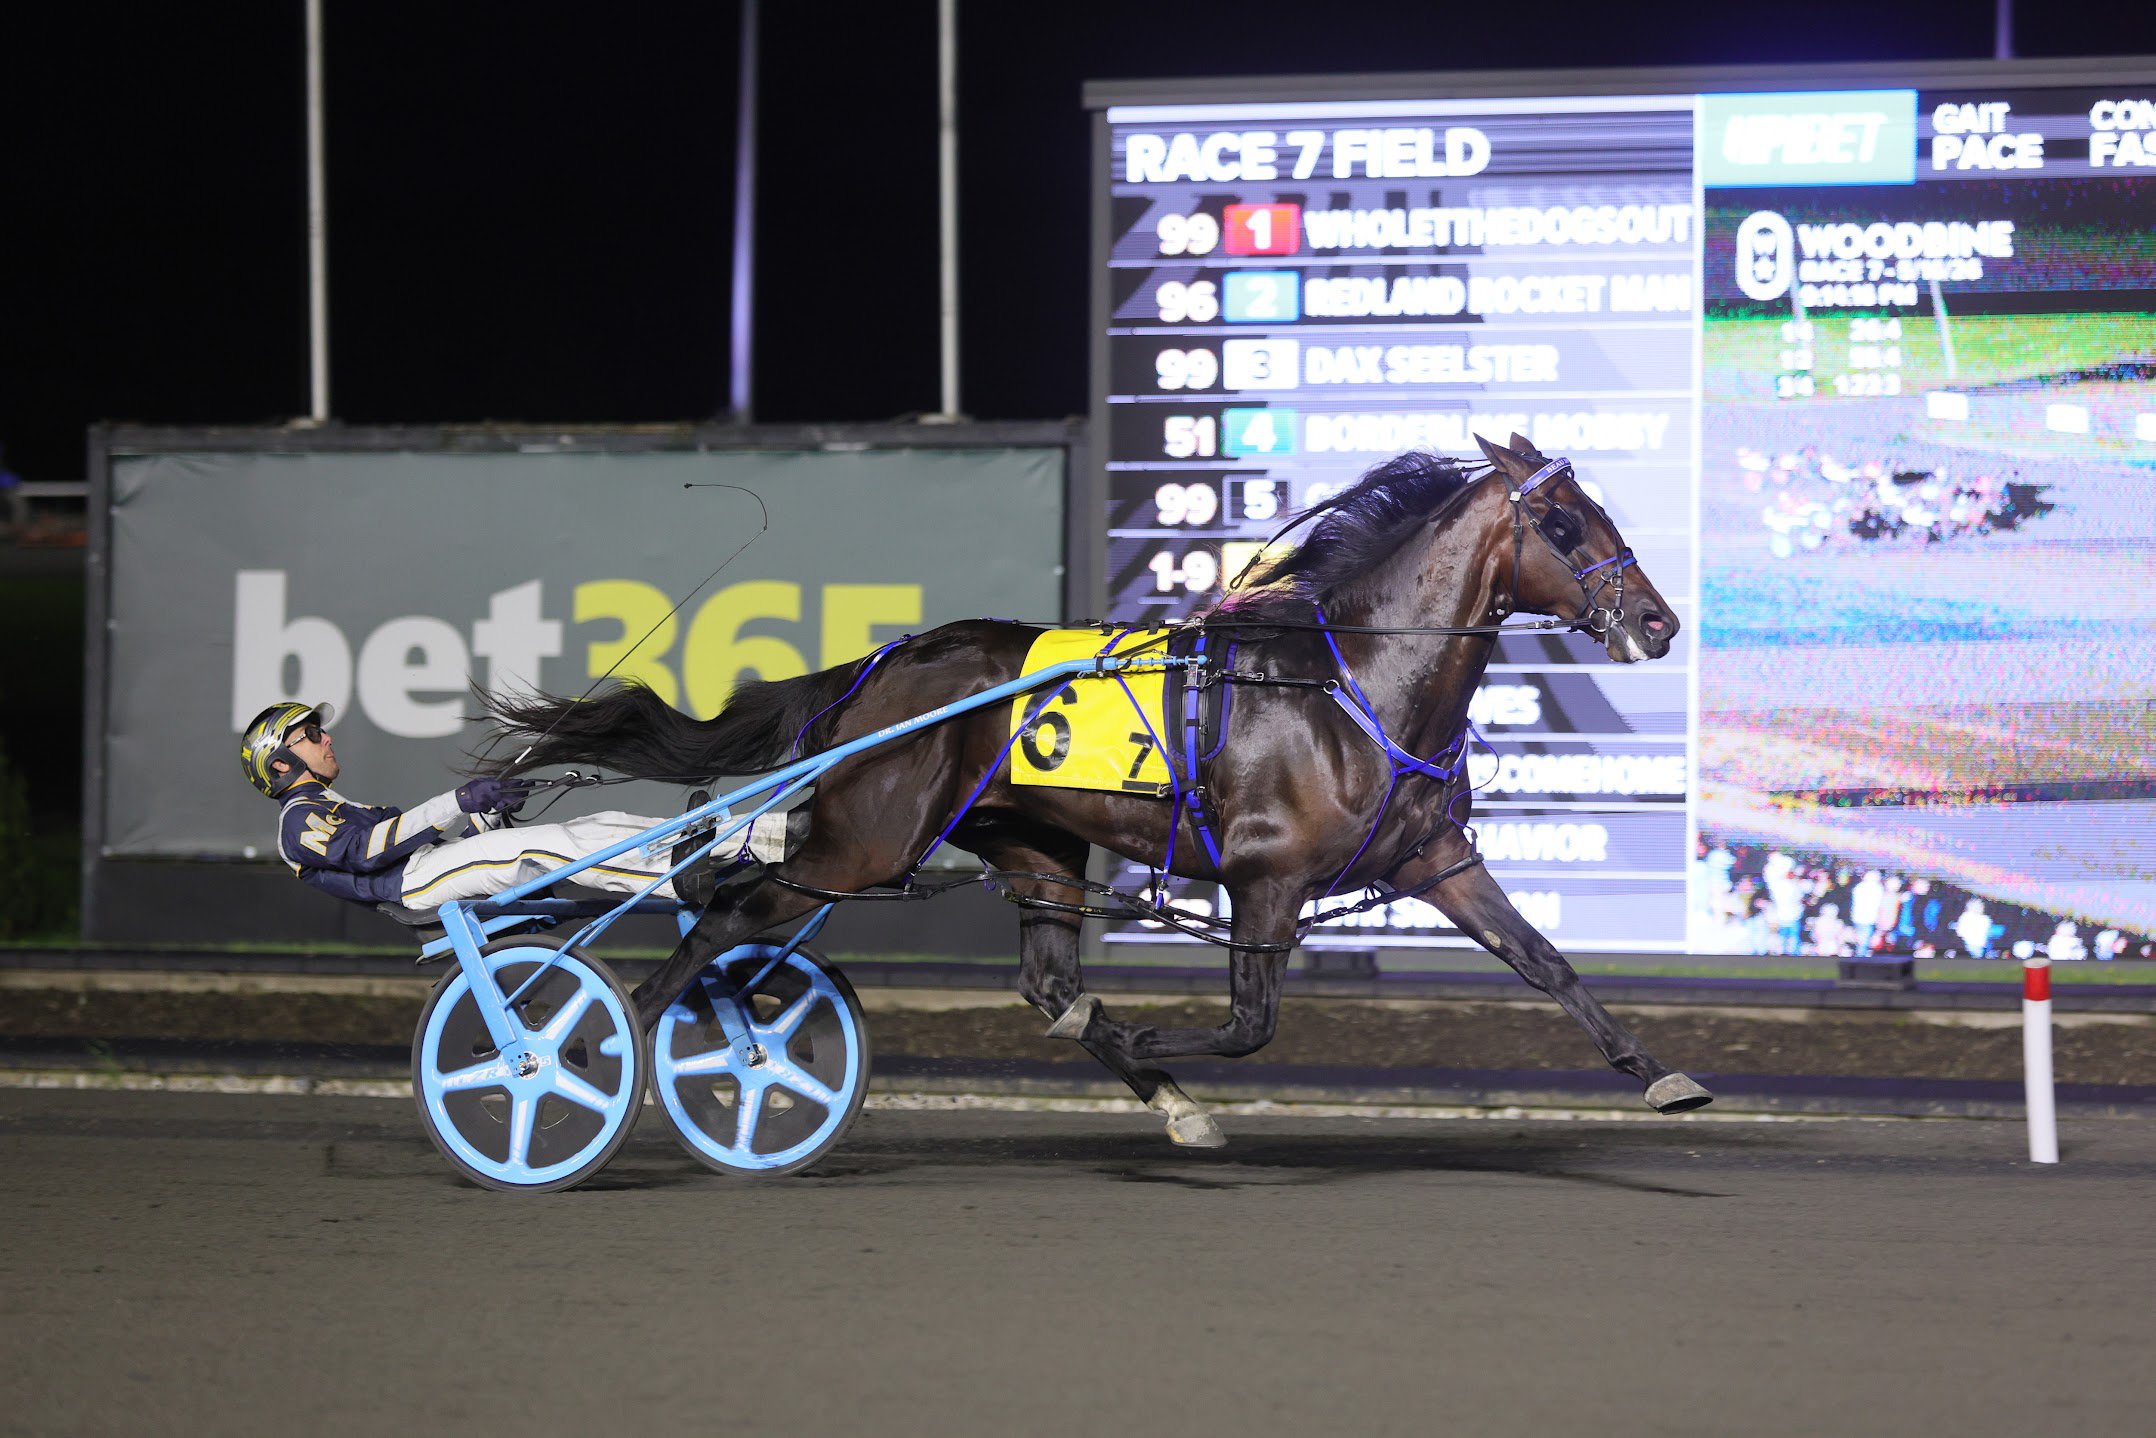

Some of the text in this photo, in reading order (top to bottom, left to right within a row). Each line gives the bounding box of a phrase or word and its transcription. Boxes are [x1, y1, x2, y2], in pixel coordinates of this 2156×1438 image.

[1932, 102, 2011, 134] GAIT
[1126, 128, 1491, 182] RACE 7 FIELD
[1932, 133, 2044, 170] PACE
[1156, 205, 1692, 255] 99 1 WHOLETTHEDOGSOUT
[1797, 221, 2015, 260] WOODBINE
[1800, 259, 1865, 282] RACE
[1867, 259, 1885, 281] 7
[1156, 273, 1691, 323] 96 2 REDLAND ROCKET MAN
[1156, 345, 1559, 390] 99 3 DAX SEELSTER
[1164, 416, 1216, 457] 51
[1242, 411, 1276, 450] 4
[1155, 483, 1217, 526] 99
[1244, 480, 1277, 520] 5
[1149, 551, 1217, 593] 1-9
[878, 706, 949, 738] DR. IAN MOORE
[1021, 685, 1078, 772] 6
[1129, 731, 1155, 779] 7
